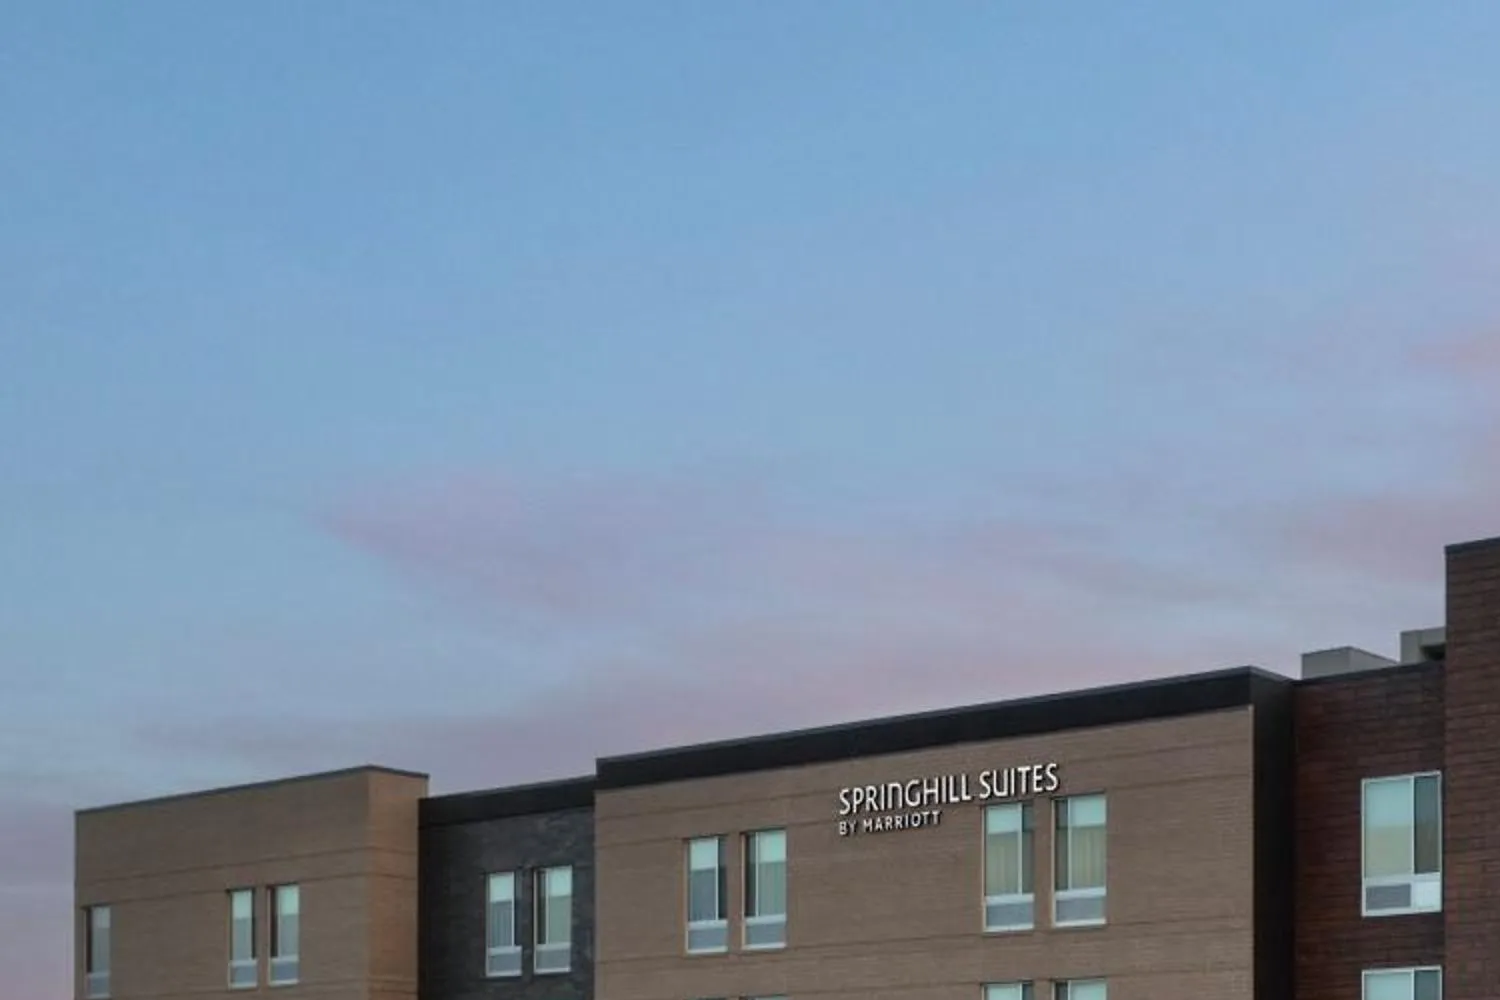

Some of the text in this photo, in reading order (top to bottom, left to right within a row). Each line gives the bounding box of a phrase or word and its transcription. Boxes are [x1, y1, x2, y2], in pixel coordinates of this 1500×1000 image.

[838, 763, 1060, 815] SPRINGHILL SUITES
[838, 810, 941, 835] BY MARRIOTT
